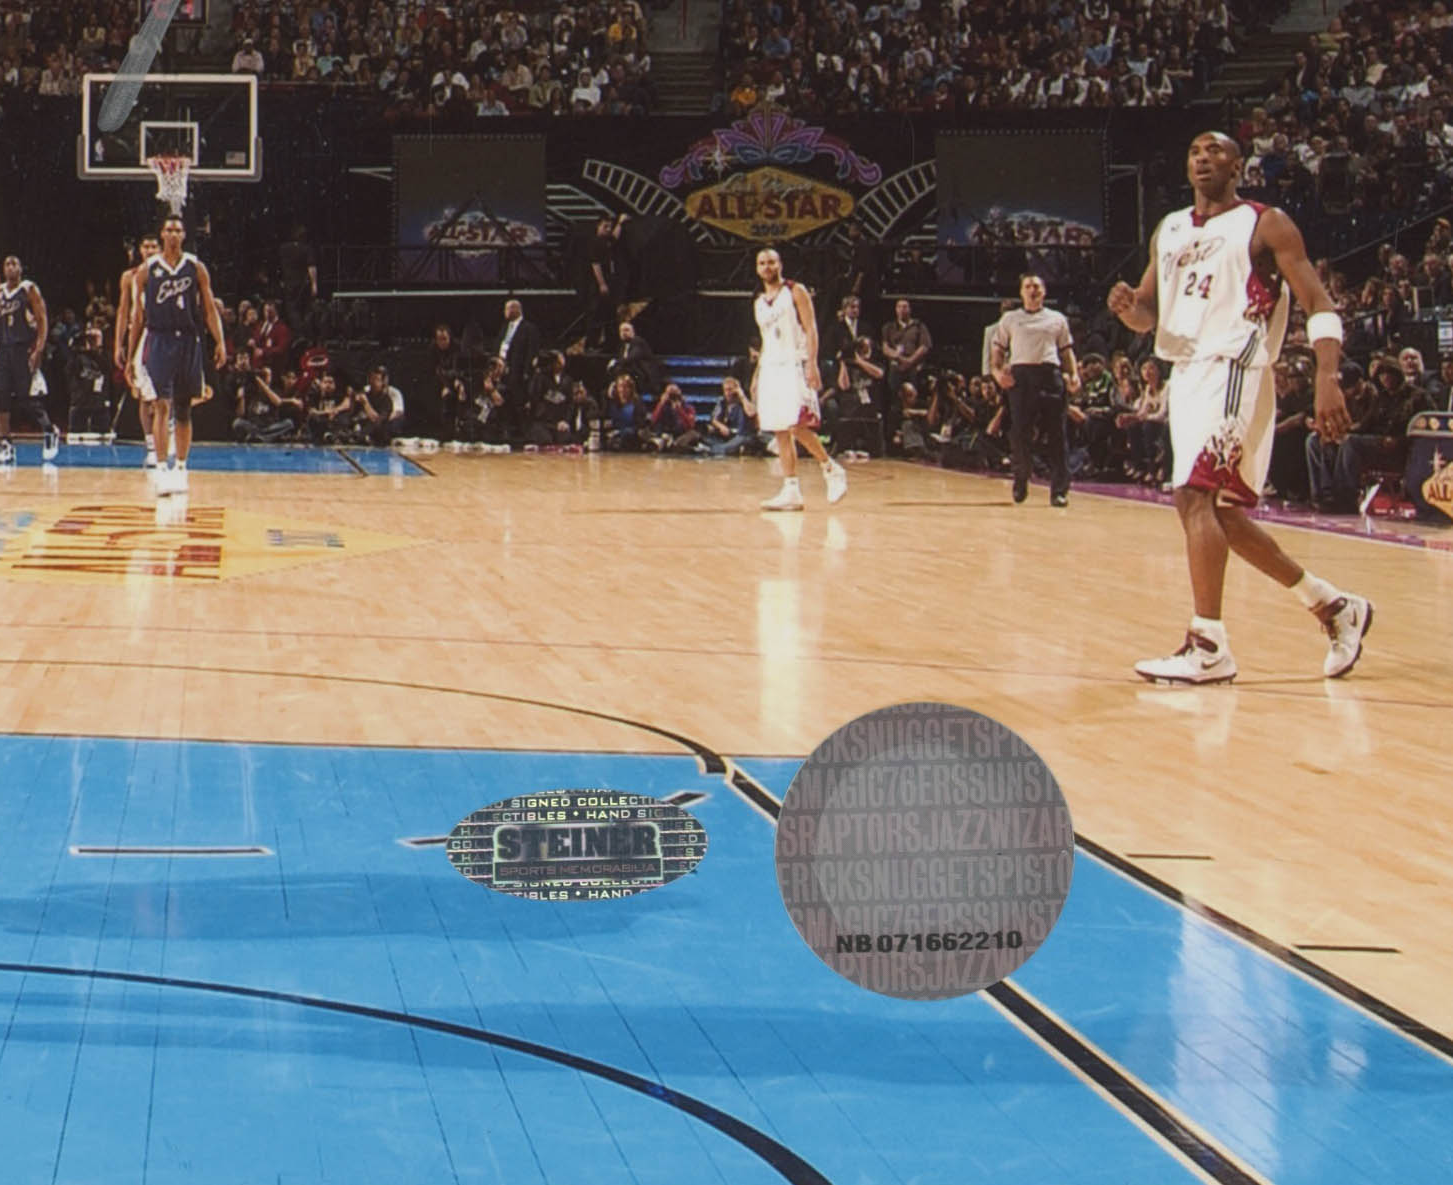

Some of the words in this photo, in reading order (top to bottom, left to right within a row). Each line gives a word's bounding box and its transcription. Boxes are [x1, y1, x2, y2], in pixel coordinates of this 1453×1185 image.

[762, 192, 844, 221] STAR
[1183, 270, 1214, 301] 24
[510, 798, 571, 809] SIGNED
[586, 809, 631, 820] HAND
[496, 825, 660, 860] STEINER
[499, 865, 556, 877] SPORTS
[559, 863, 657, 876] MEMORABILIA
